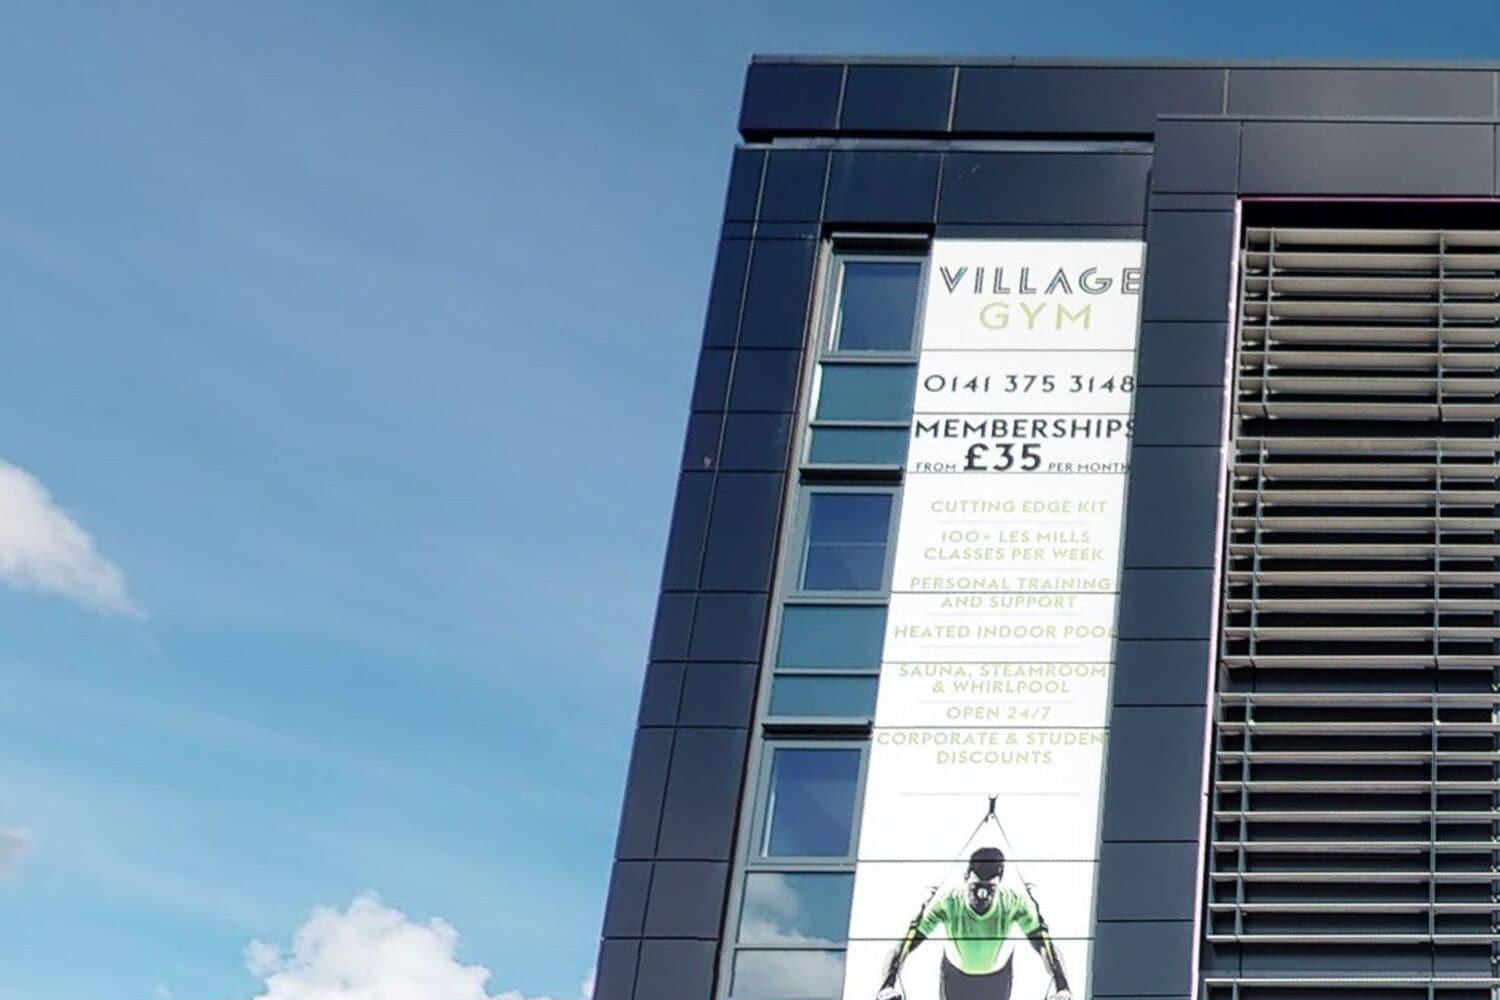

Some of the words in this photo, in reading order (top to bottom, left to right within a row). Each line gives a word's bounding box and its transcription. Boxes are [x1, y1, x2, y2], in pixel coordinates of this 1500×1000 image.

[939, 267, 1142, 295] VILLAGE
[979, 302, 1092, 330] GYM
[924, 374, 990, 393] 0141
[1004, 375, 1055, 393] 375
[1069, 375, 1135, 393] 3148
[914, 419, 1135, 438] MEMBERSHIPS
[916, 462, 956, 472] FROM
[963, 443, 1042, 471] £35
[1048, 462, 1073, 472] PER
[930, 500, 1016, 513] CUTTING
[1022, 500, 1071, 513] EDGE
[1077, 500, 1107, 513] KIT
[941, 530, 991, 543] 100+
[998, 530, 1030, 543] LES
[1036, 530, 1091, 543] MILLS
[924, 547, 1005, 561] CLASSES
[1011, 547, 1044, 561] PER
[1052, 547, 1104, 561] WEEK
[909, 577, 1011, 590] PERSONAL
[1017, 577, 1112, 590] TRAINING
[940, 595, 983, 609] AND
[989, 595, 1078, 609] SUPPORT
[894, 625, 971, 639] HEATED
[976, 625, 1057, 639] INDOOR
[898, 663, 973, 679] SAUNA,
[979, 663, 1107, 678] STEAMROOM
[932, 680, 945, 694] &
[953, 680, 1070, 694] WHIRLPOOL
[946, 706, 1000, 720] OPEN
[1007, 706, 1052, 720] 24/7
[877, 731, 999, 746] CORPORATE
[1005, 731, 1018, 746] &
[936, 750, 1053, 765] DISCOUNTS
